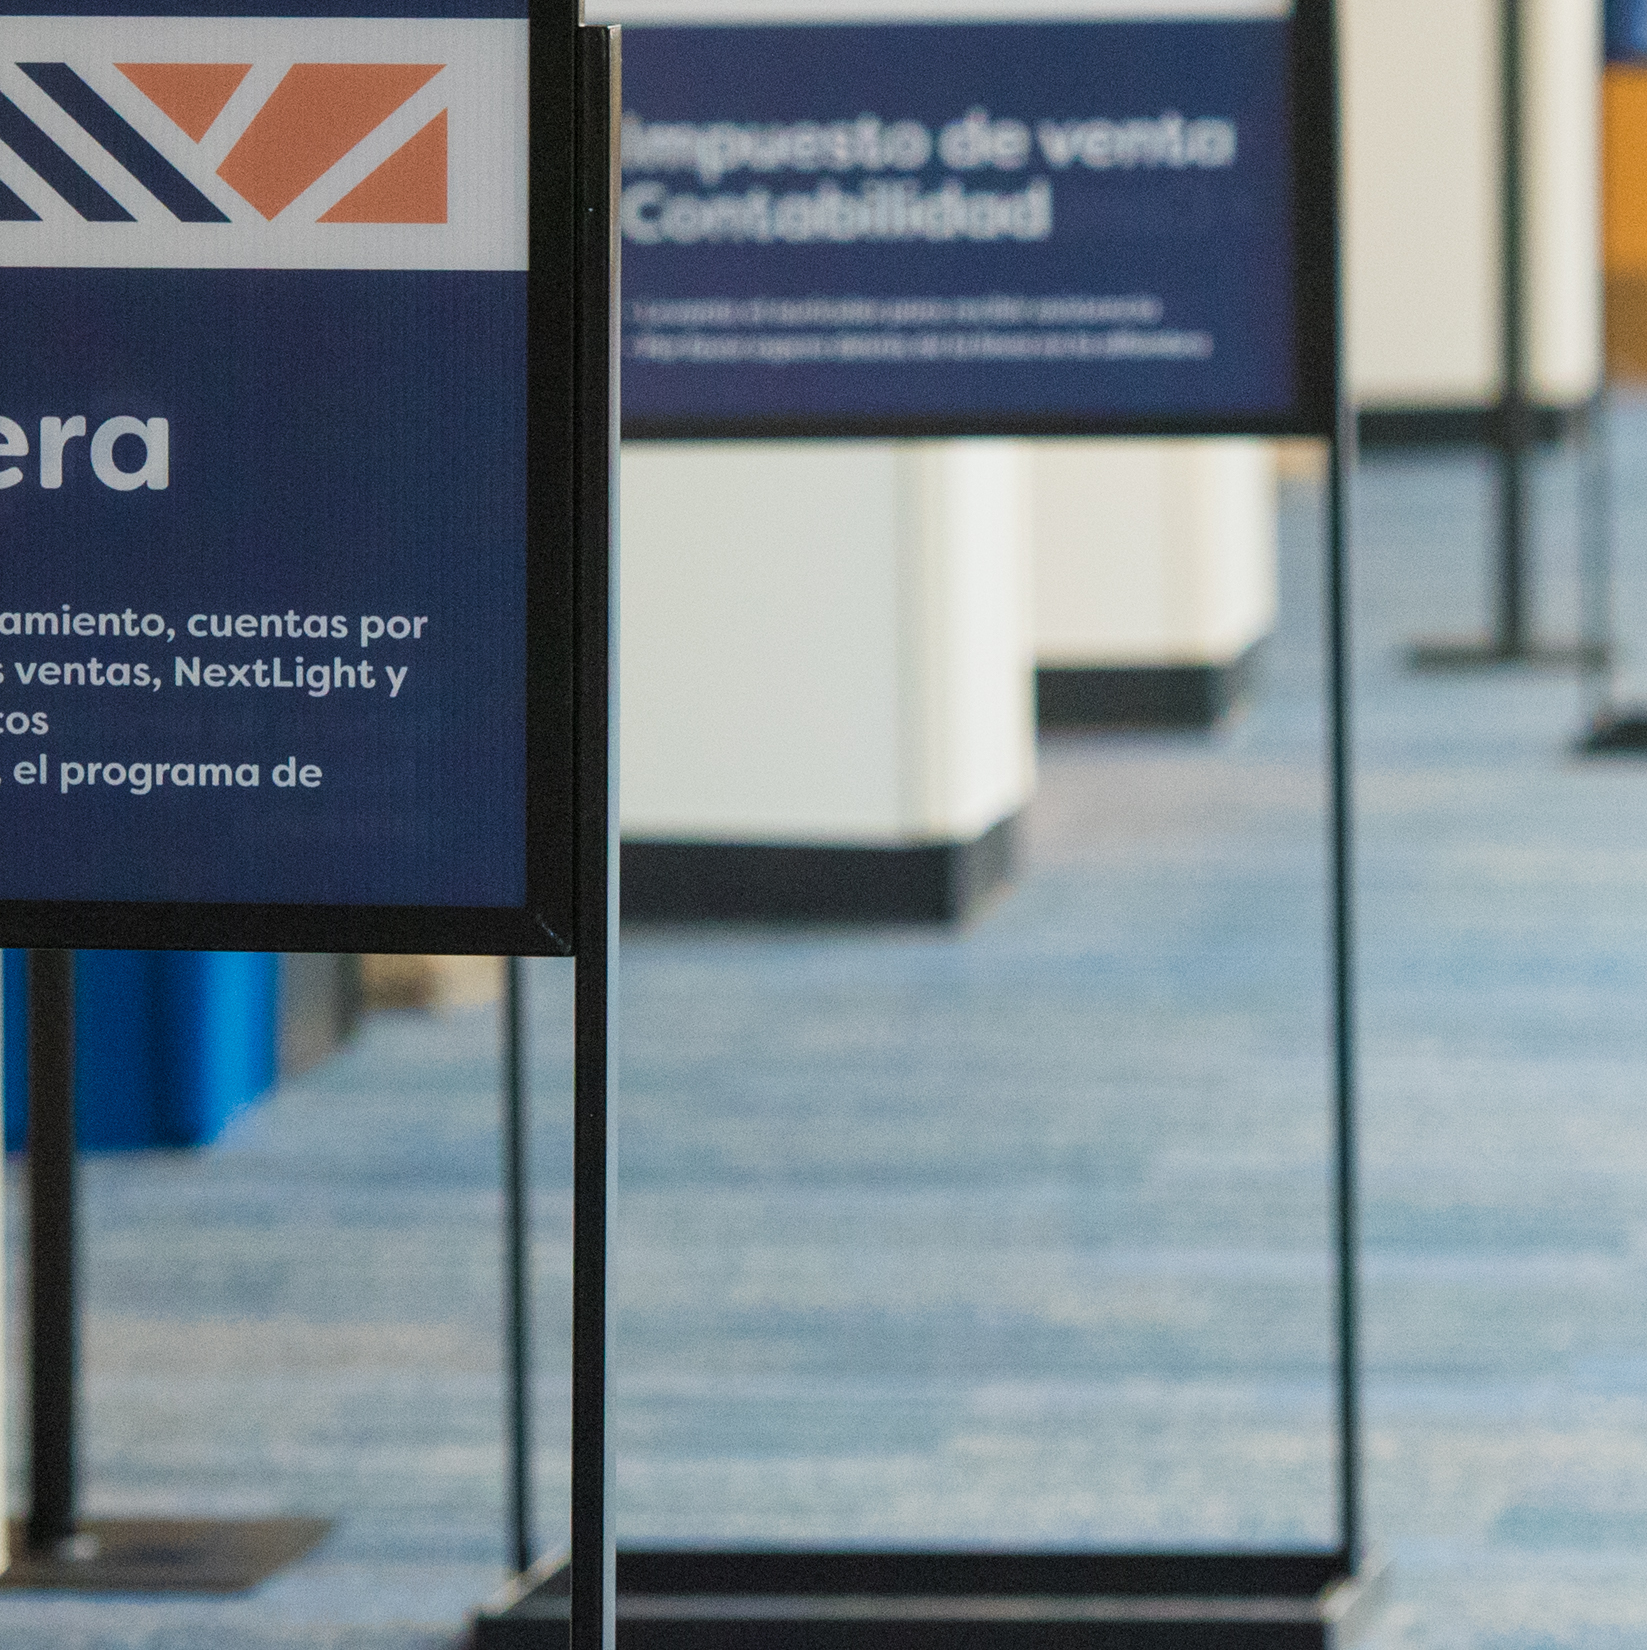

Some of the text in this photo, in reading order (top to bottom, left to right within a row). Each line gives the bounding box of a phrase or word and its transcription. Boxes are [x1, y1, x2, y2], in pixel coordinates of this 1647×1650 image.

[937, 106, 1033, 170] de
[1036, 108, 1238, 169] venta
[621, 178, 1053, 244] Contabilidad
[185, 608, 351, 641] cuentas
[358, 613, 430, 650] por
[12, 655, 164, 693] ventas,
[172, 654, 378, 700] NextLight
[383, 663, 410, 700] y
[11, 751, 49, 787] el
[58, 760, 262, 797] programa
[269, 754, 325, 790] de
